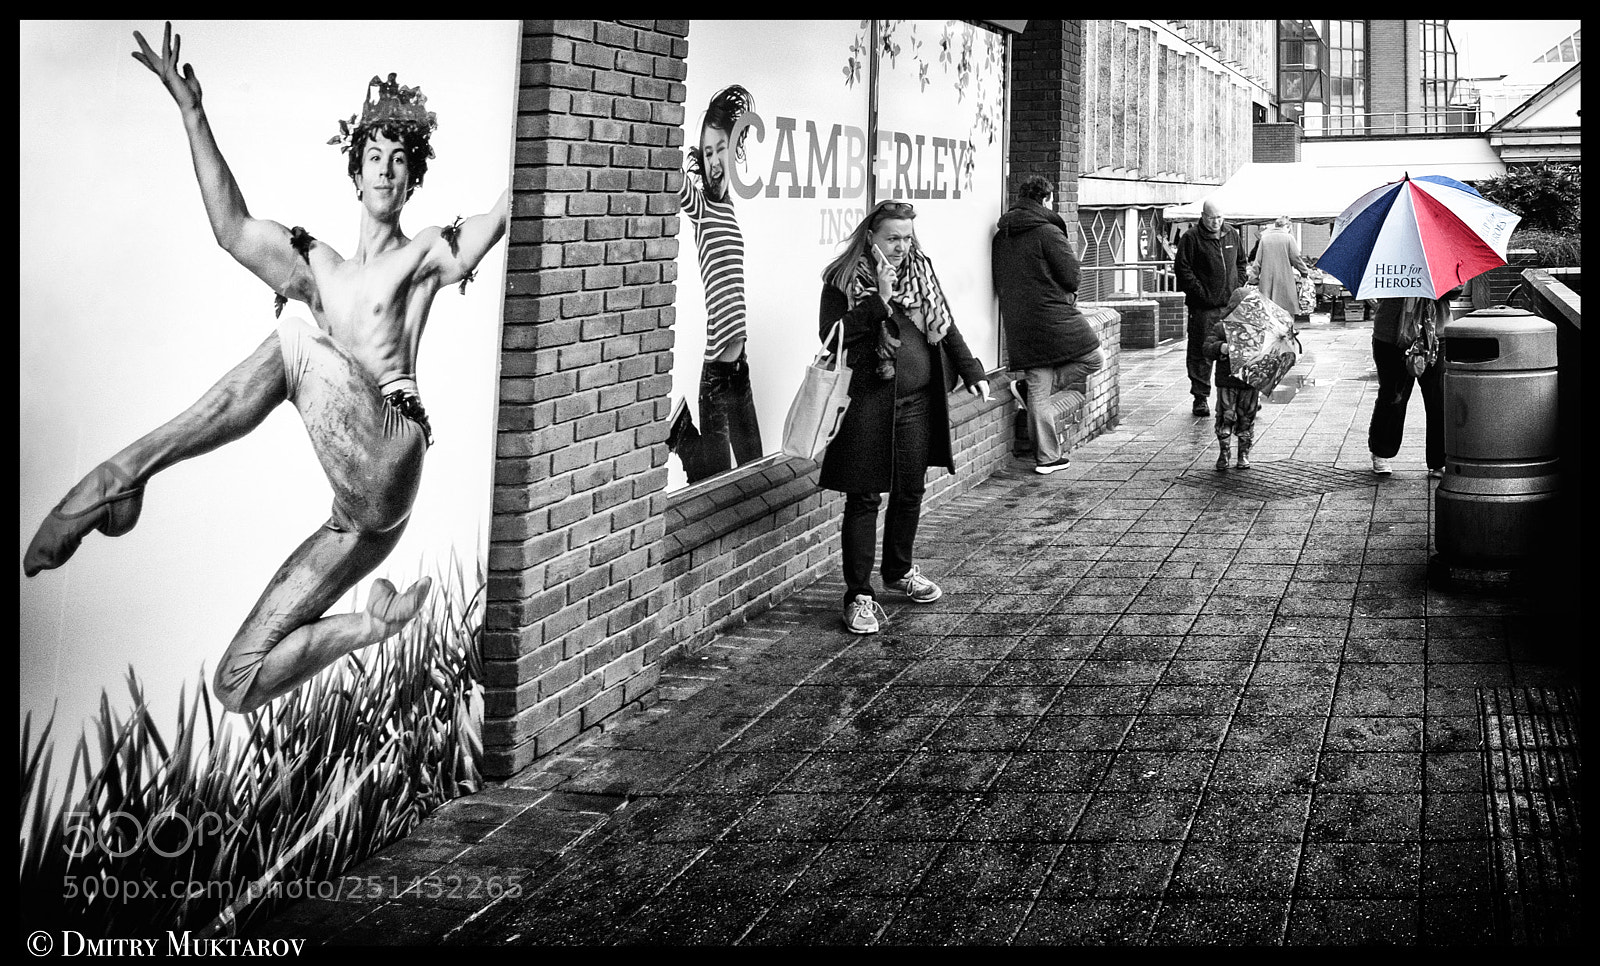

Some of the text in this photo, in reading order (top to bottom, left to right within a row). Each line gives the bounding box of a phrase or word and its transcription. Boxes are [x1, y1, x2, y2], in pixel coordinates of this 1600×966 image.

[728, 111, 967, 200] CAMBERLEY
[1375, 263, 1422, 277] HELP for
[1375, 276, 1422, 288] HEROES
